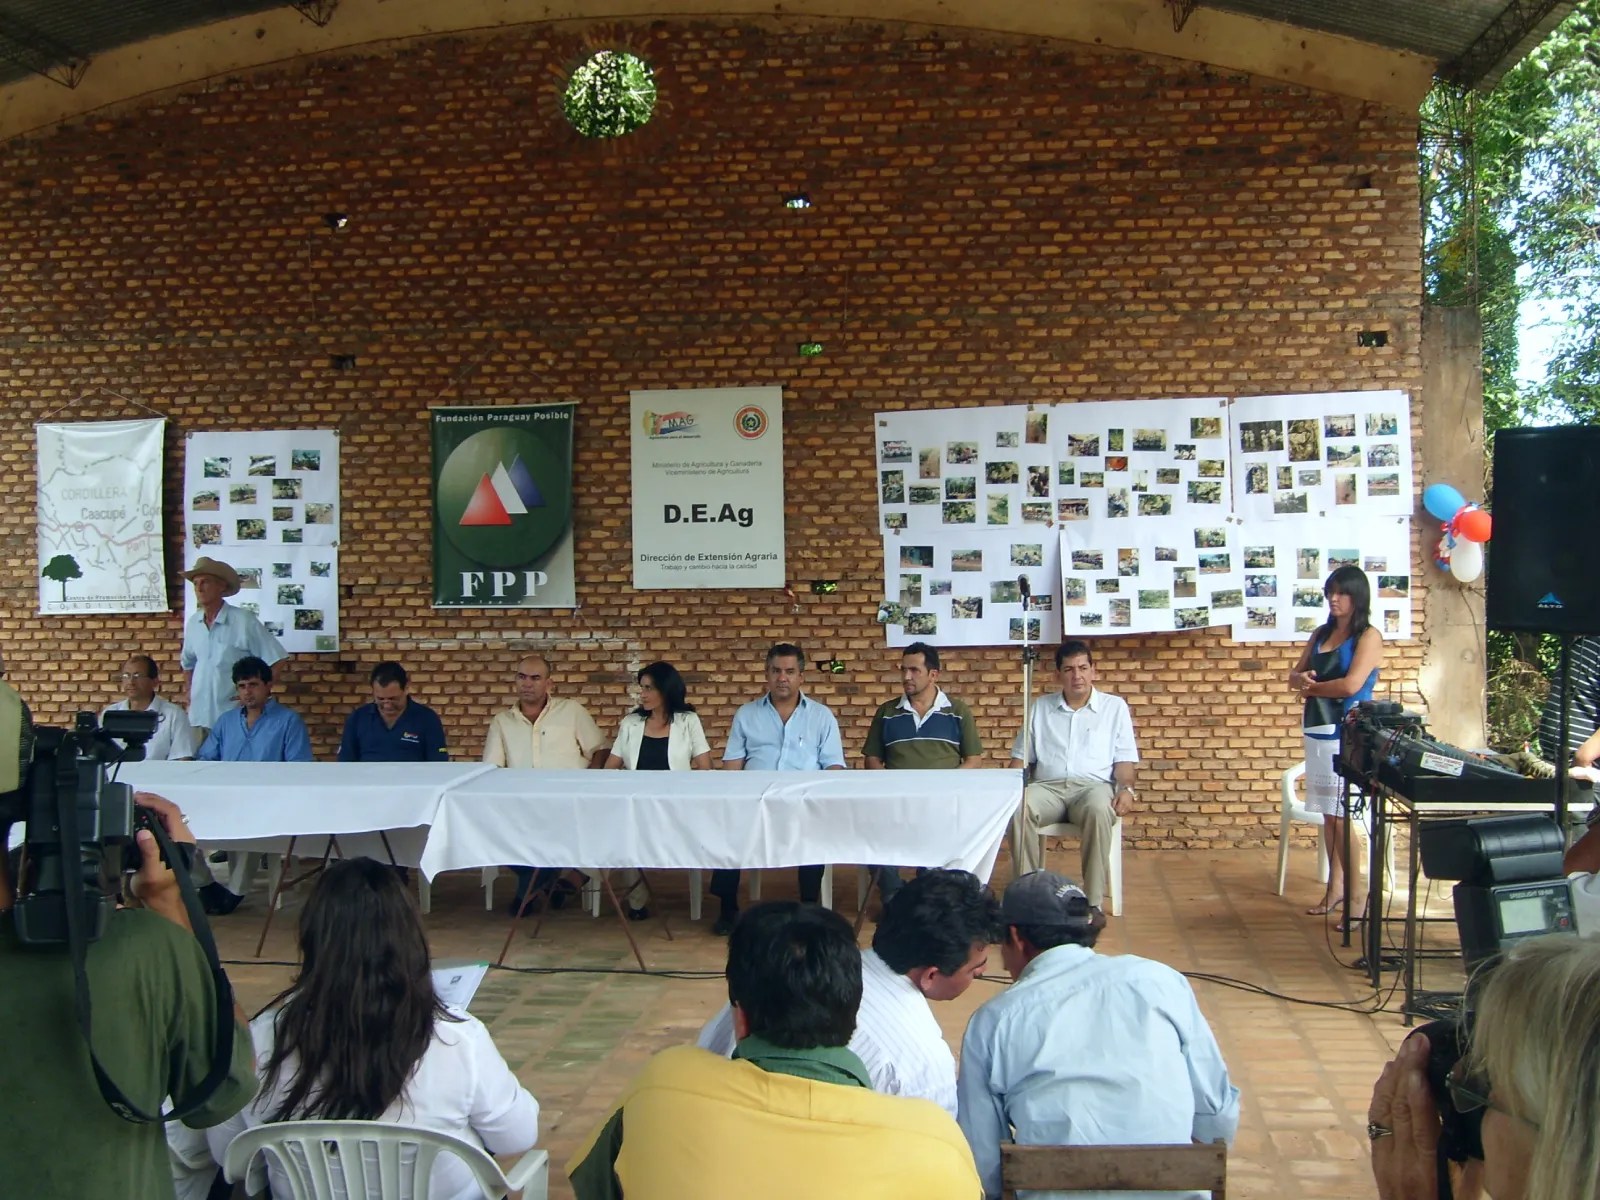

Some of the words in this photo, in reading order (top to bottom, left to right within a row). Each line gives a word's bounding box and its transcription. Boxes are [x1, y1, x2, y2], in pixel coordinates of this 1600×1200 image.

[435, 414, 484, 423] Fundación
[487, 413, 531, 422] Paraguay
[534, 412, 569, 420] Posible
[668, 414, 695, 429] MAG
[61, 486, 128, 501] CORDILLERA
[81, 505, 126, 522] Caacupé
[664, 503, 754, 527] D.E.Ag
[640, 553, 682, 562] Dirección
[684, 553, 696, 561] de
[698, 552, 743, 561] Extensión
[745, 552, 778, 562] Agraria
[459, 571, 549, 598] FPP
